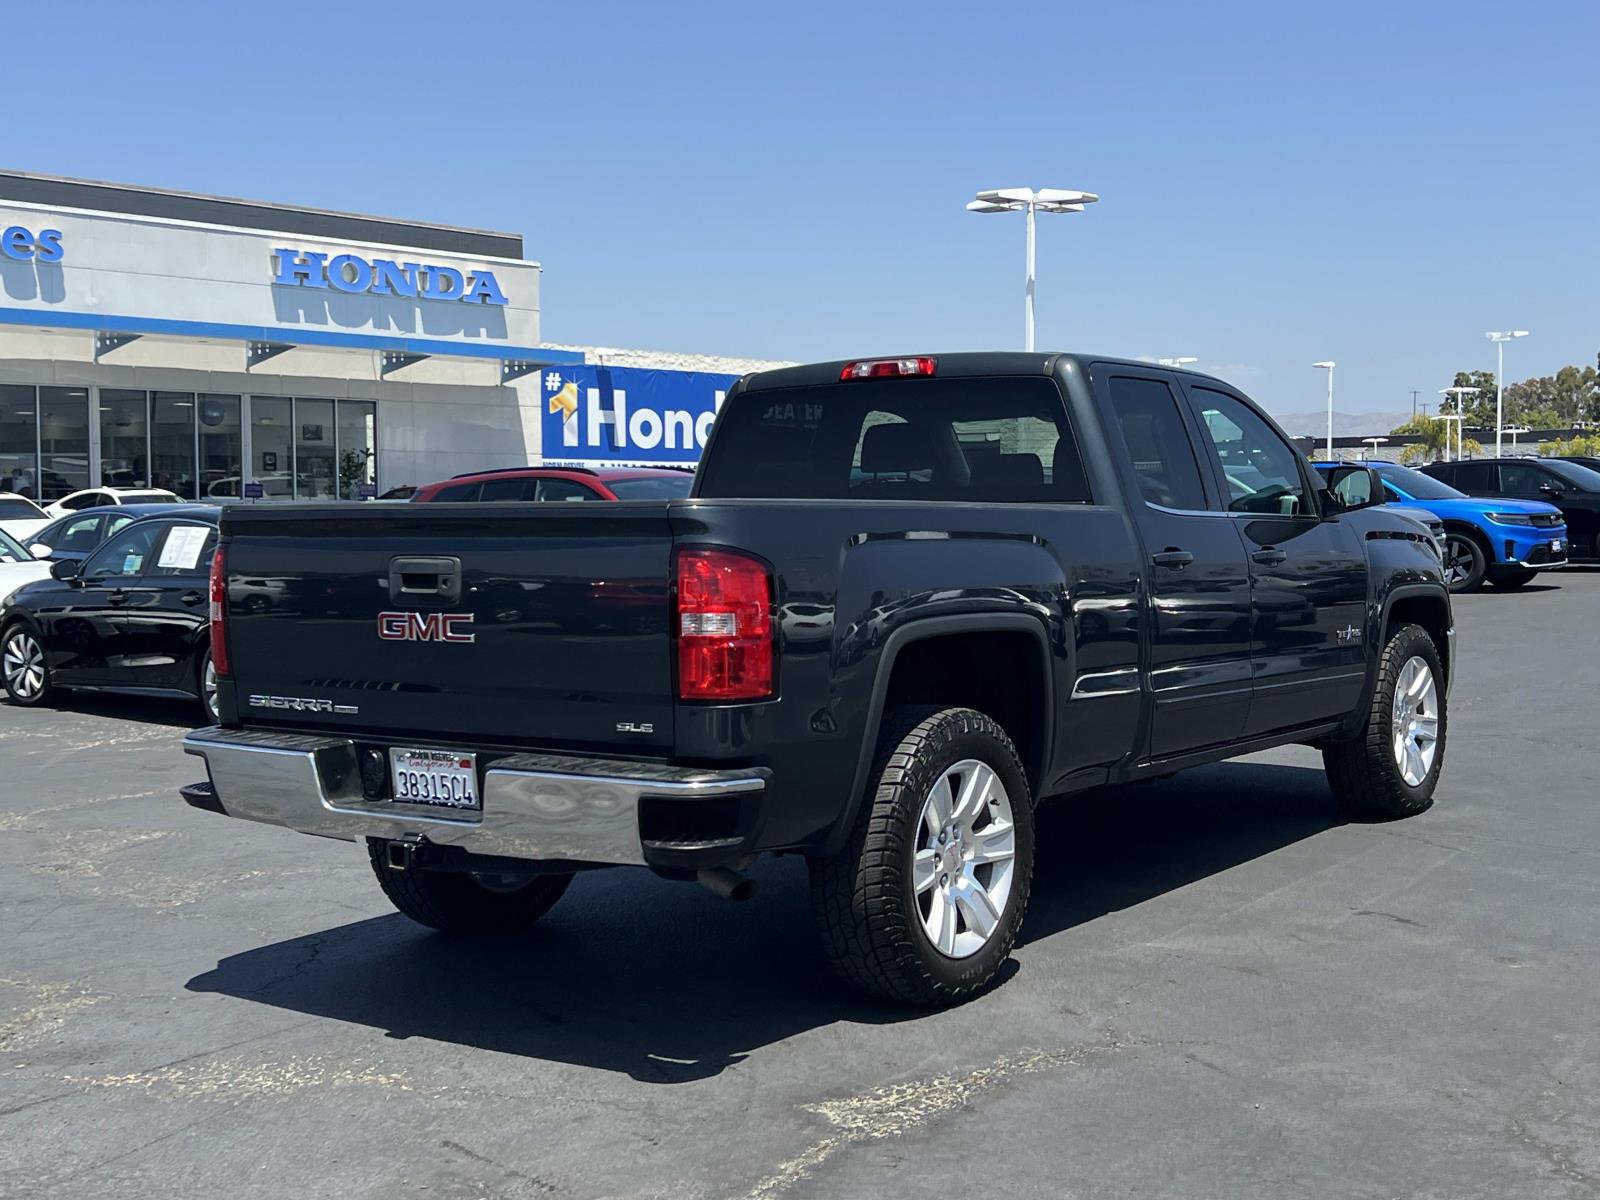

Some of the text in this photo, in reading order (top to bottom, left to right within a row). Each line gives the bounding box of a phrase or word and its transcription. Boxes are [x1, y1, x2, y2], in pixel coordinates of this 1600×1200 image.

[275, 248, 509, 305] HONDA
[378, 611, 475, 642] GMC
[249, 694, 333, 712] SIERRA
[398, 771, 473, 803] 38315C4
